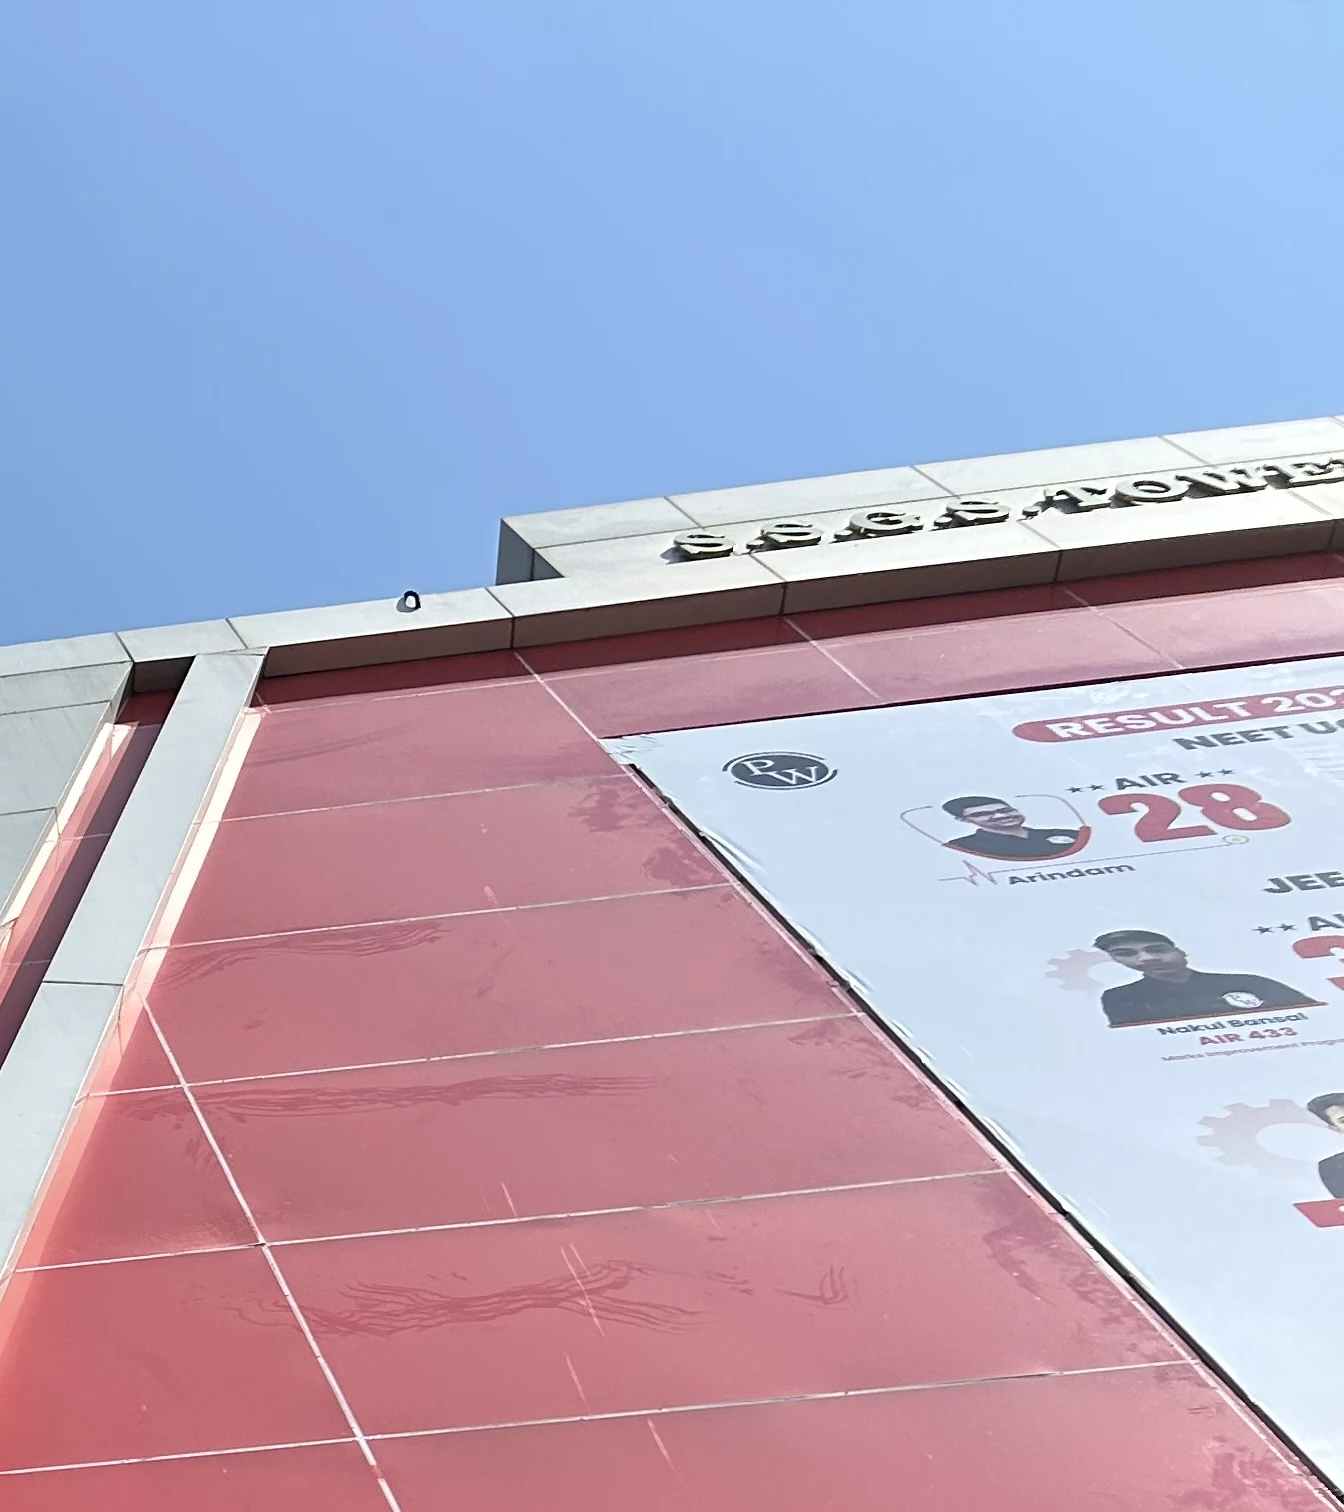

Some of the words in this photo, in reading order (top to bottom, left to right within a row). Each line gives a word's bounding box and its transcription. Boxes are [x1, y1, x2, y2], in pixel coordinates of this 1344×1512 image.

[1045, 700, 1255, 739] RESULT
[1173, 725, 1294, 750] NEET
[1297, 718, 1344, 735] U
[1114, 771, 1188, 791] AIR
[1098, 783, 1292, 843] 28
[1008, 863, 1136, 886] Arindam
[1156, 1020, 1227, 1036] Nakul
[1226, 1012, 1310, 1029] Bansal
[1199, 1032, 1244, 1046] AIR
[1248, 1026, 1299, 1040] 433
